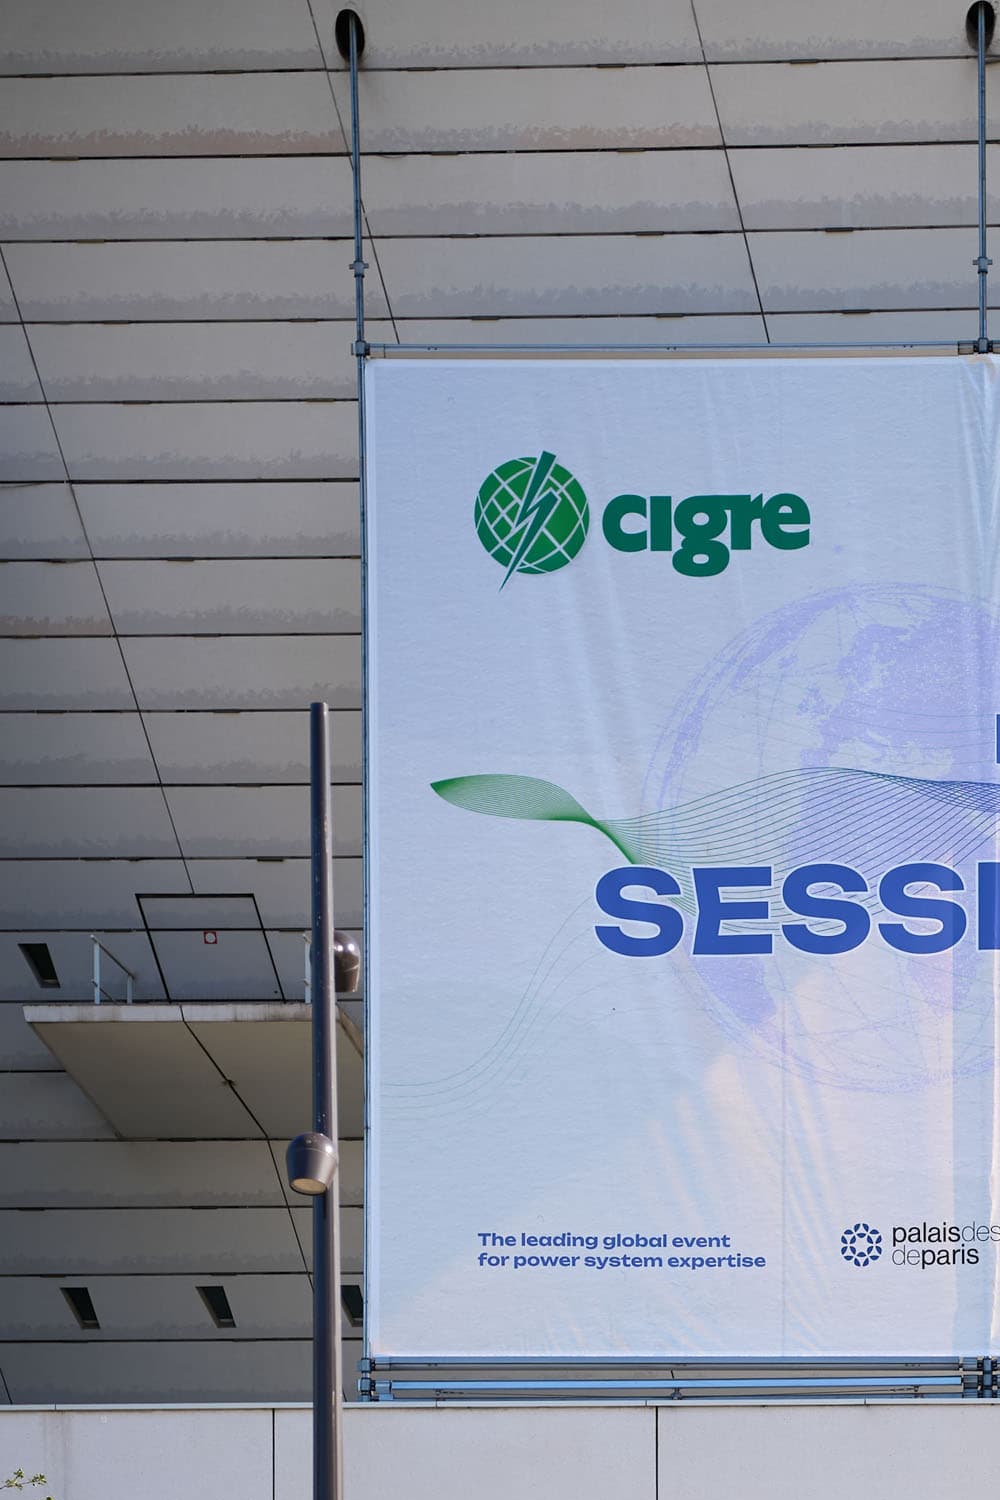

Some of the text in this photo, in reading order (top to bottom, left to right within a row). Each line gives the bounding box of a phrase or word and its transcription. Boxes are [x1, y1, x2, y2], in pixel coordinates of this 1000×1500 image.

[602, 493, 811, 577] cigre
[478, 1232, 731, 1250] The leading global event
[478, 1252, 767, 1270] for power system expertise
